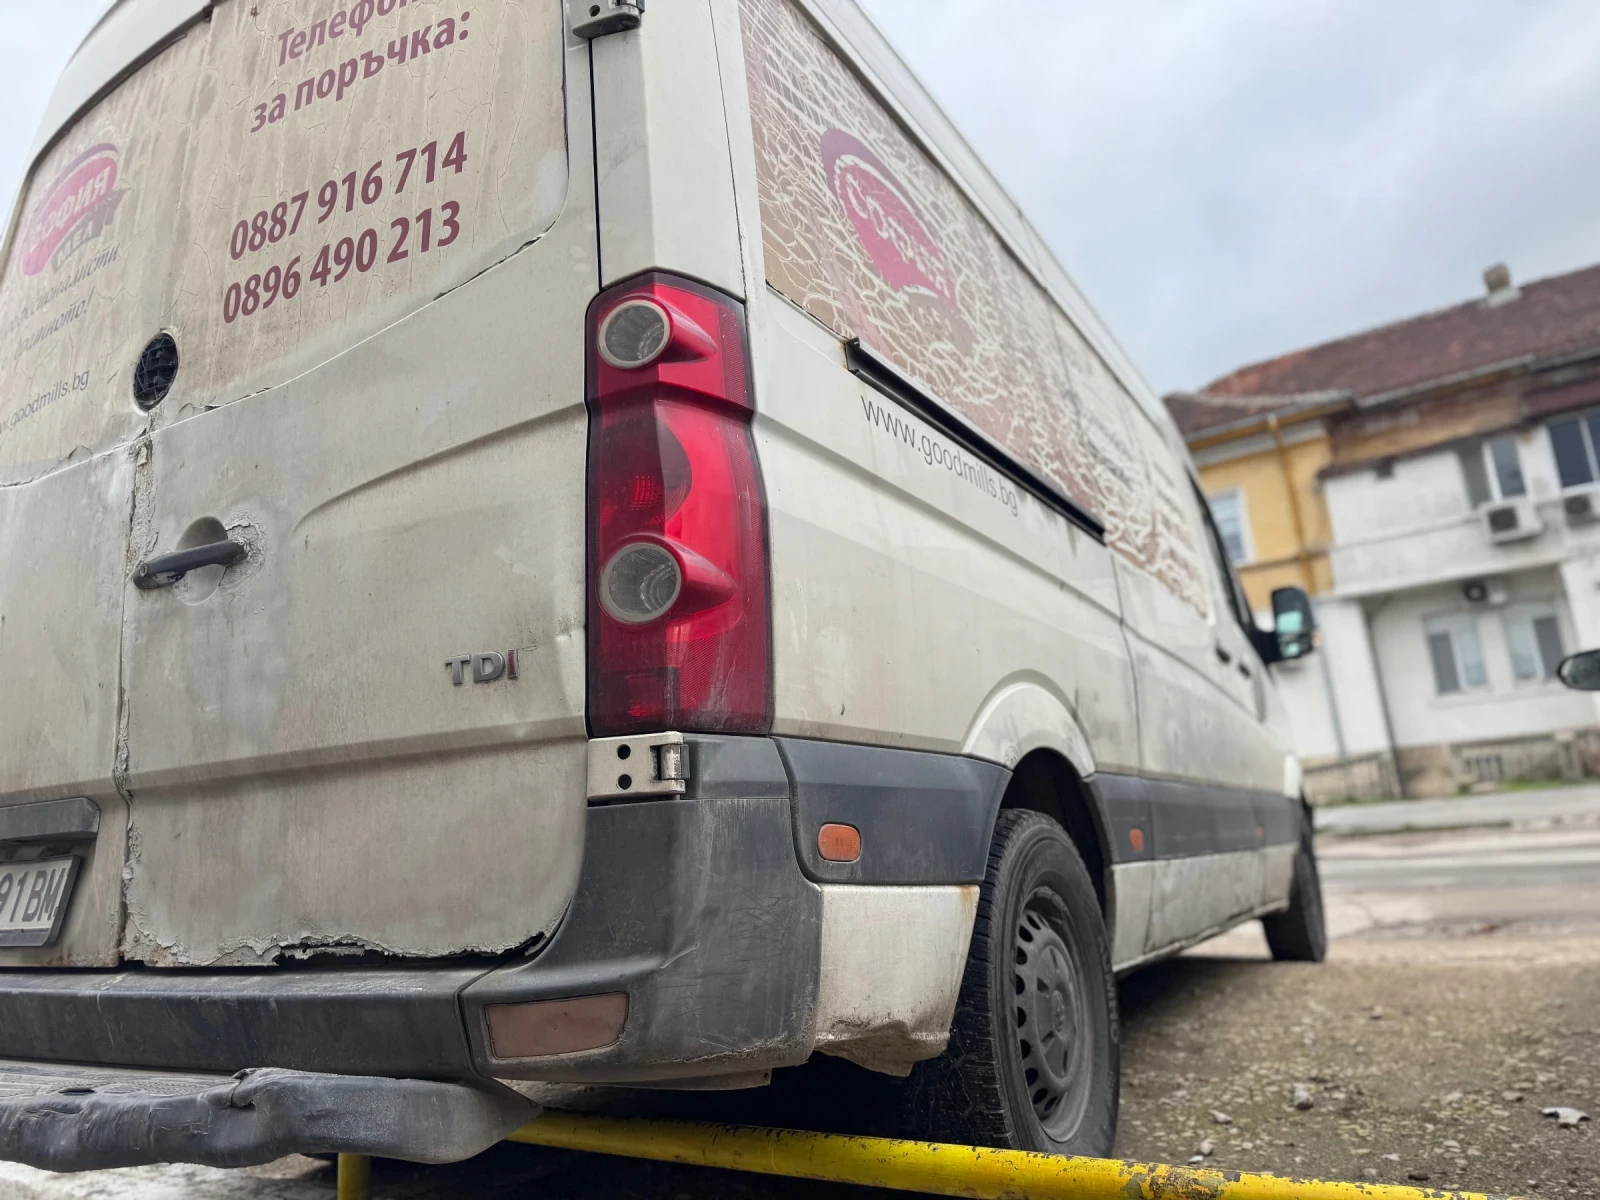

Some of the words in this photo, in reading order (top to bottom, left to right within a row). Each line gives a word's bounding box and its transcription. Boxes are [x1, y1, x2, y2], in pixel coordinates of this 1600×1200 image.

[250, 93, 286, 133] за
[294, 11, 471, 111] поръчка:
[278, 0, 419, 67] Телефо
[230, 190, 309, 260] 0887
[317, 160, 383, 224] 916
[394, 130, 468, 195] 714
[223, 255, 301, 324] 0896
[309, 228, 378, 288] 490
[387, 200, 461, 264] 213
[861, 395, 1018, 517] www.goodmills.bg
[444, 648, 520, 687] TDI
